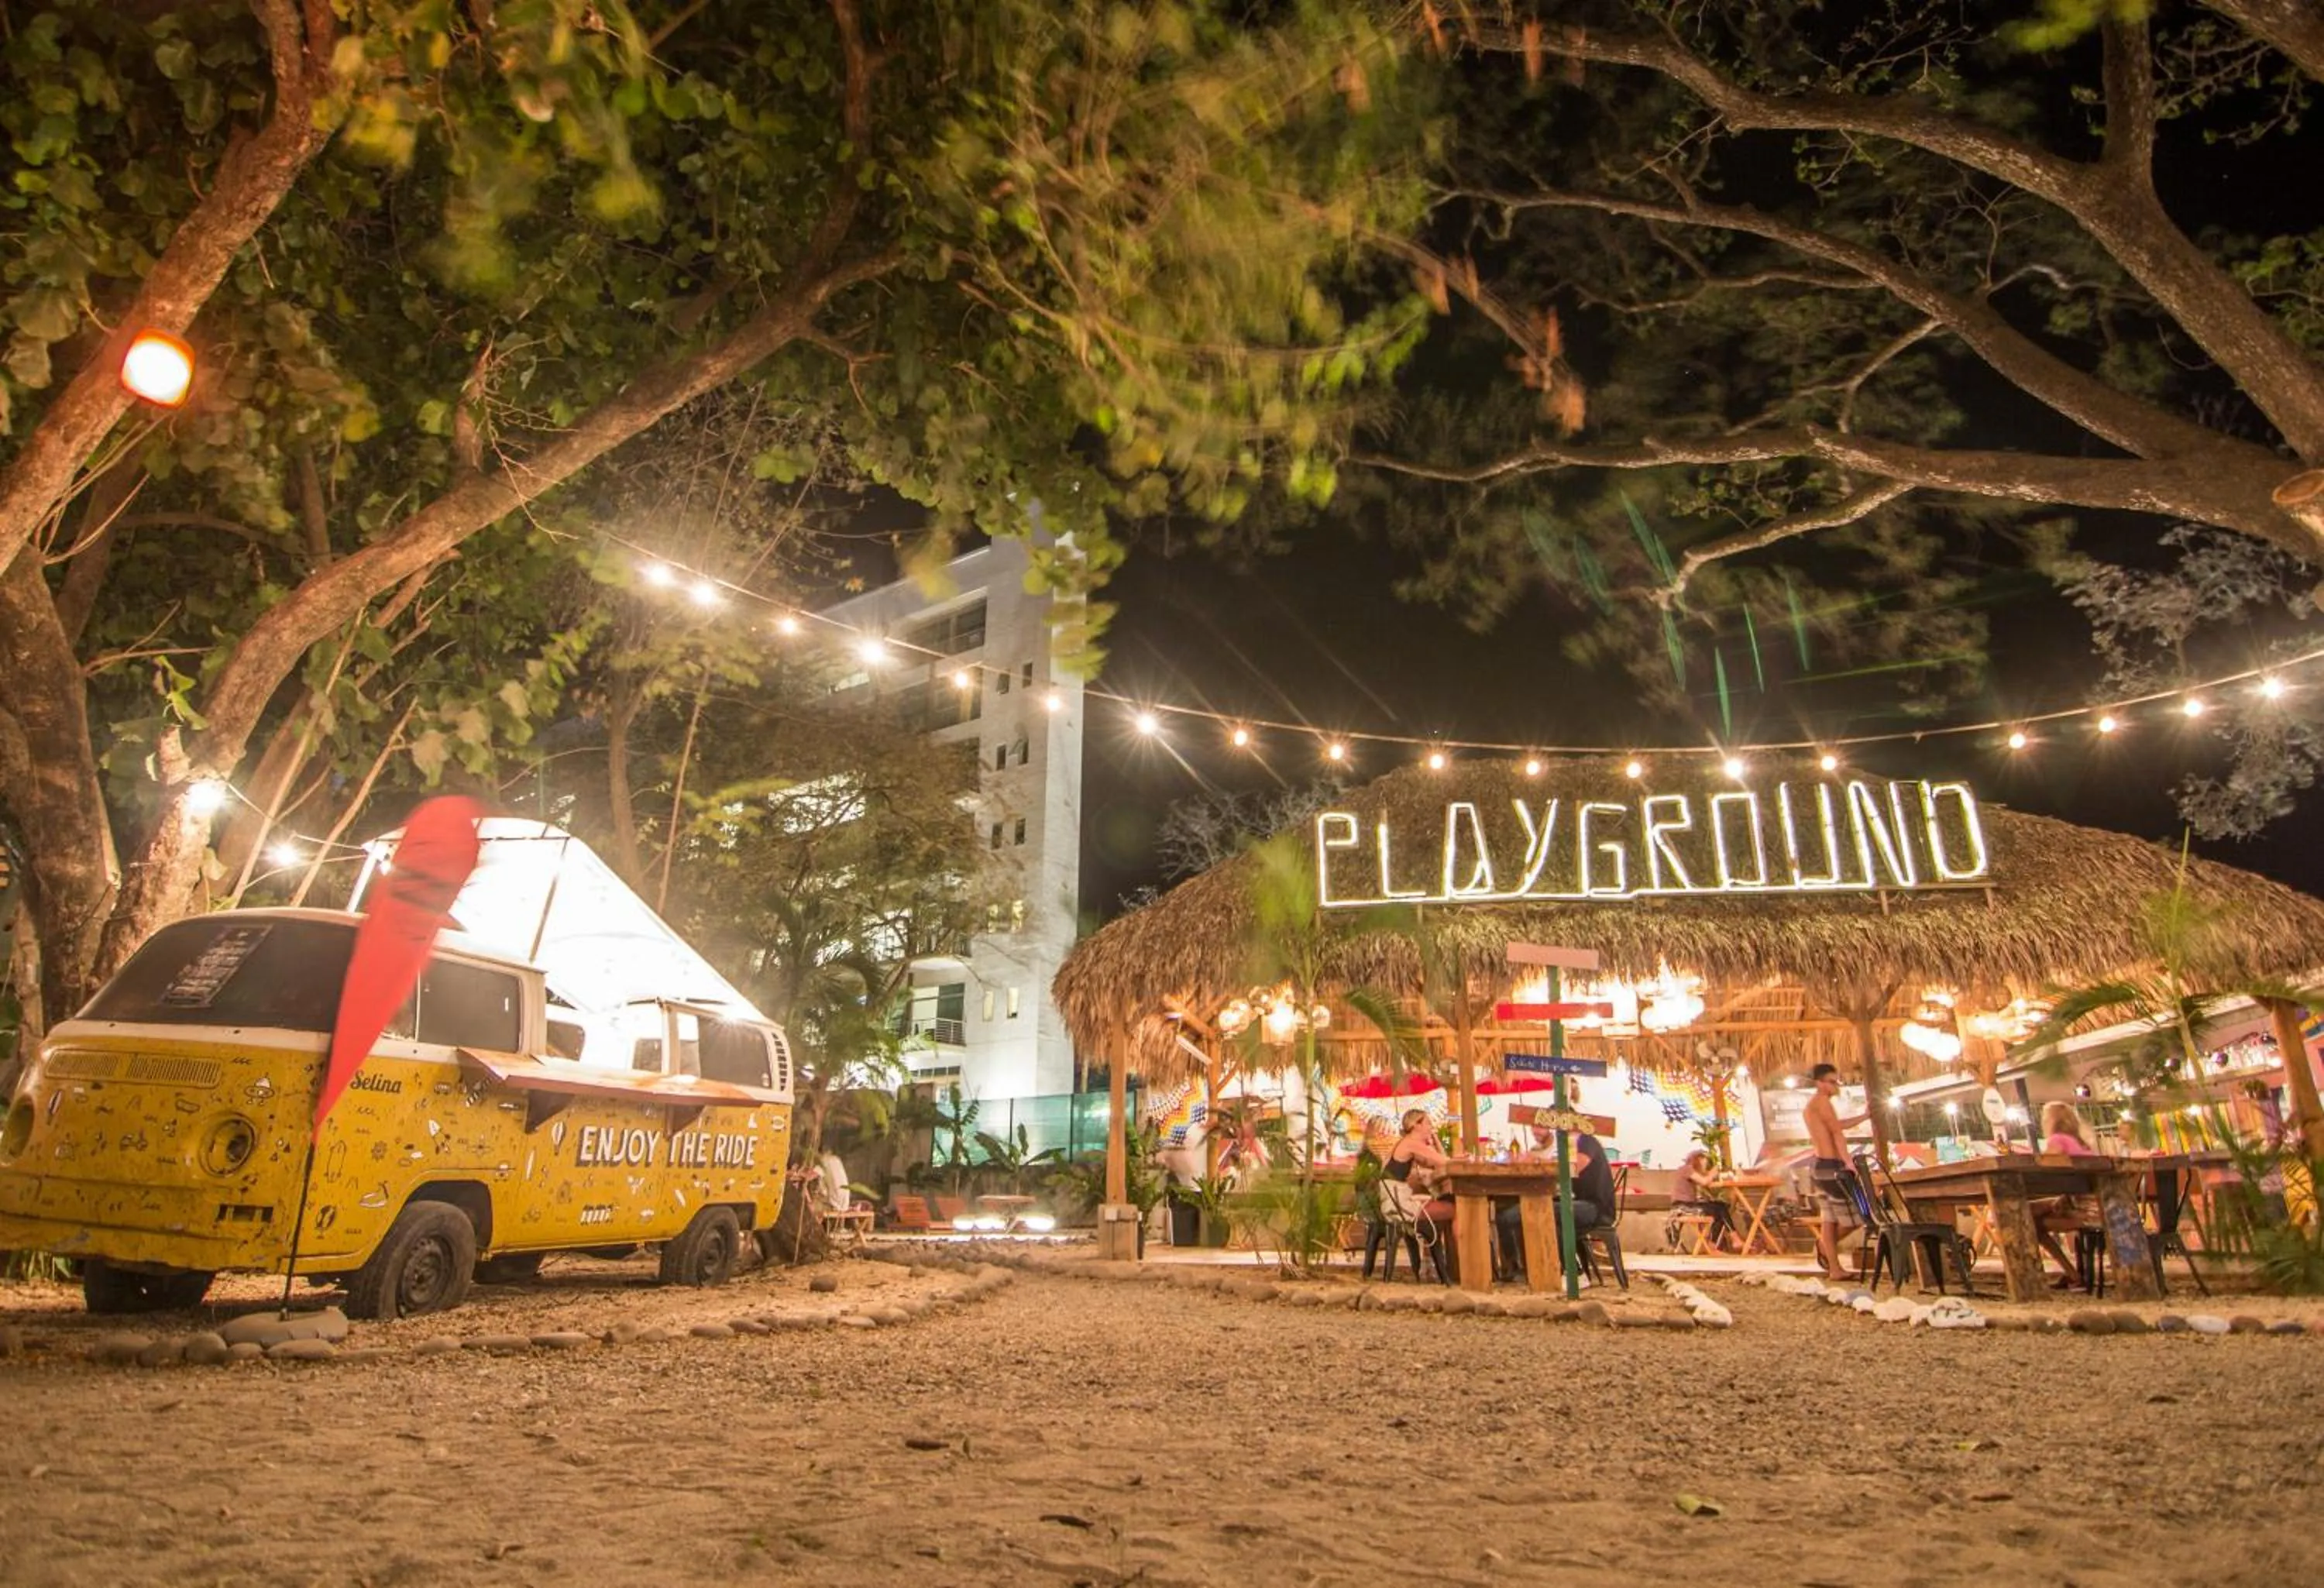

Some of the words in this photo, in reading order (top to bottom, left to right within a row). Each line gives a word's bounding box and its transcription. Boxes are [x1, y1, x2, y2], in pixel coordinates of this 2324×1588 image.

[1318, 779, 1987, 908] PLAYGROUND
[350, 1070, 402, 1094] Selina
[576, 1126, 661, 1167] ENJOY
[668, 1131, 711, 1167] THE
[711, 1133, 758, 1168] RIDE
